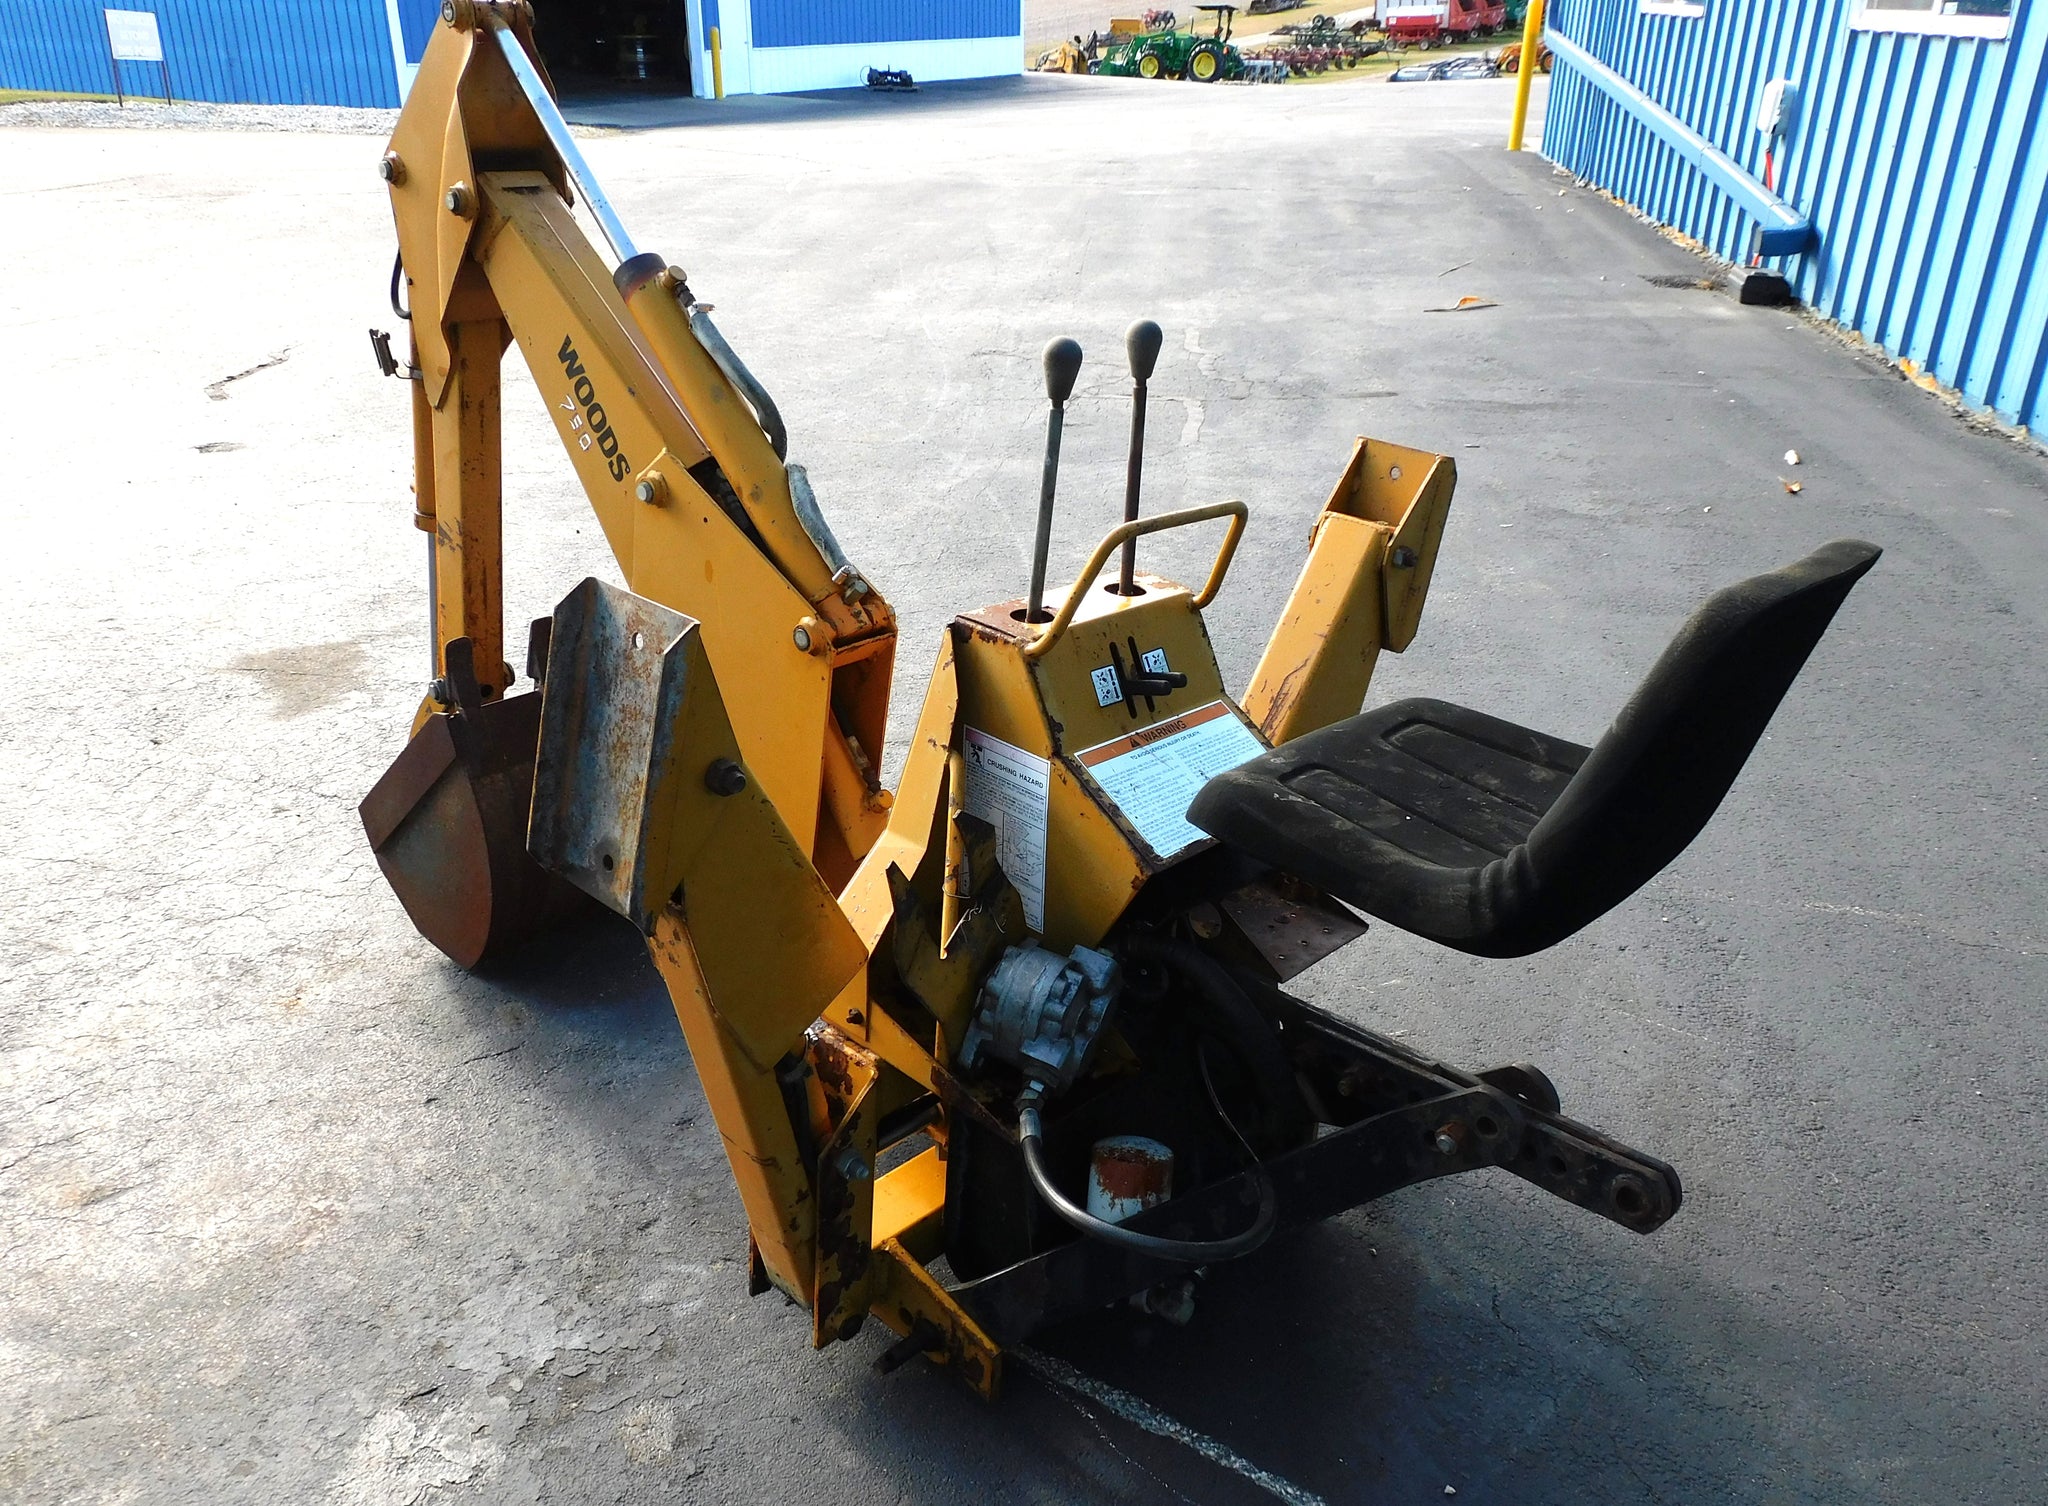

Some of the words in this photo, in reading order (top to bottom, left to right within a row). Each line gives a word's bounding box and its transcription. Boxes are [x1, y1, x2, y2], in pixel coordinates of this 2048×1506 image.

[557, 333, 631, 483] WOODS
[559, 394, 592, 451] 750
[1141, 720, 1187, 743] WARNING
[987, 758, 1017, 777] CRUSHING
[1019, 772, 1044, 789] HAZARD
